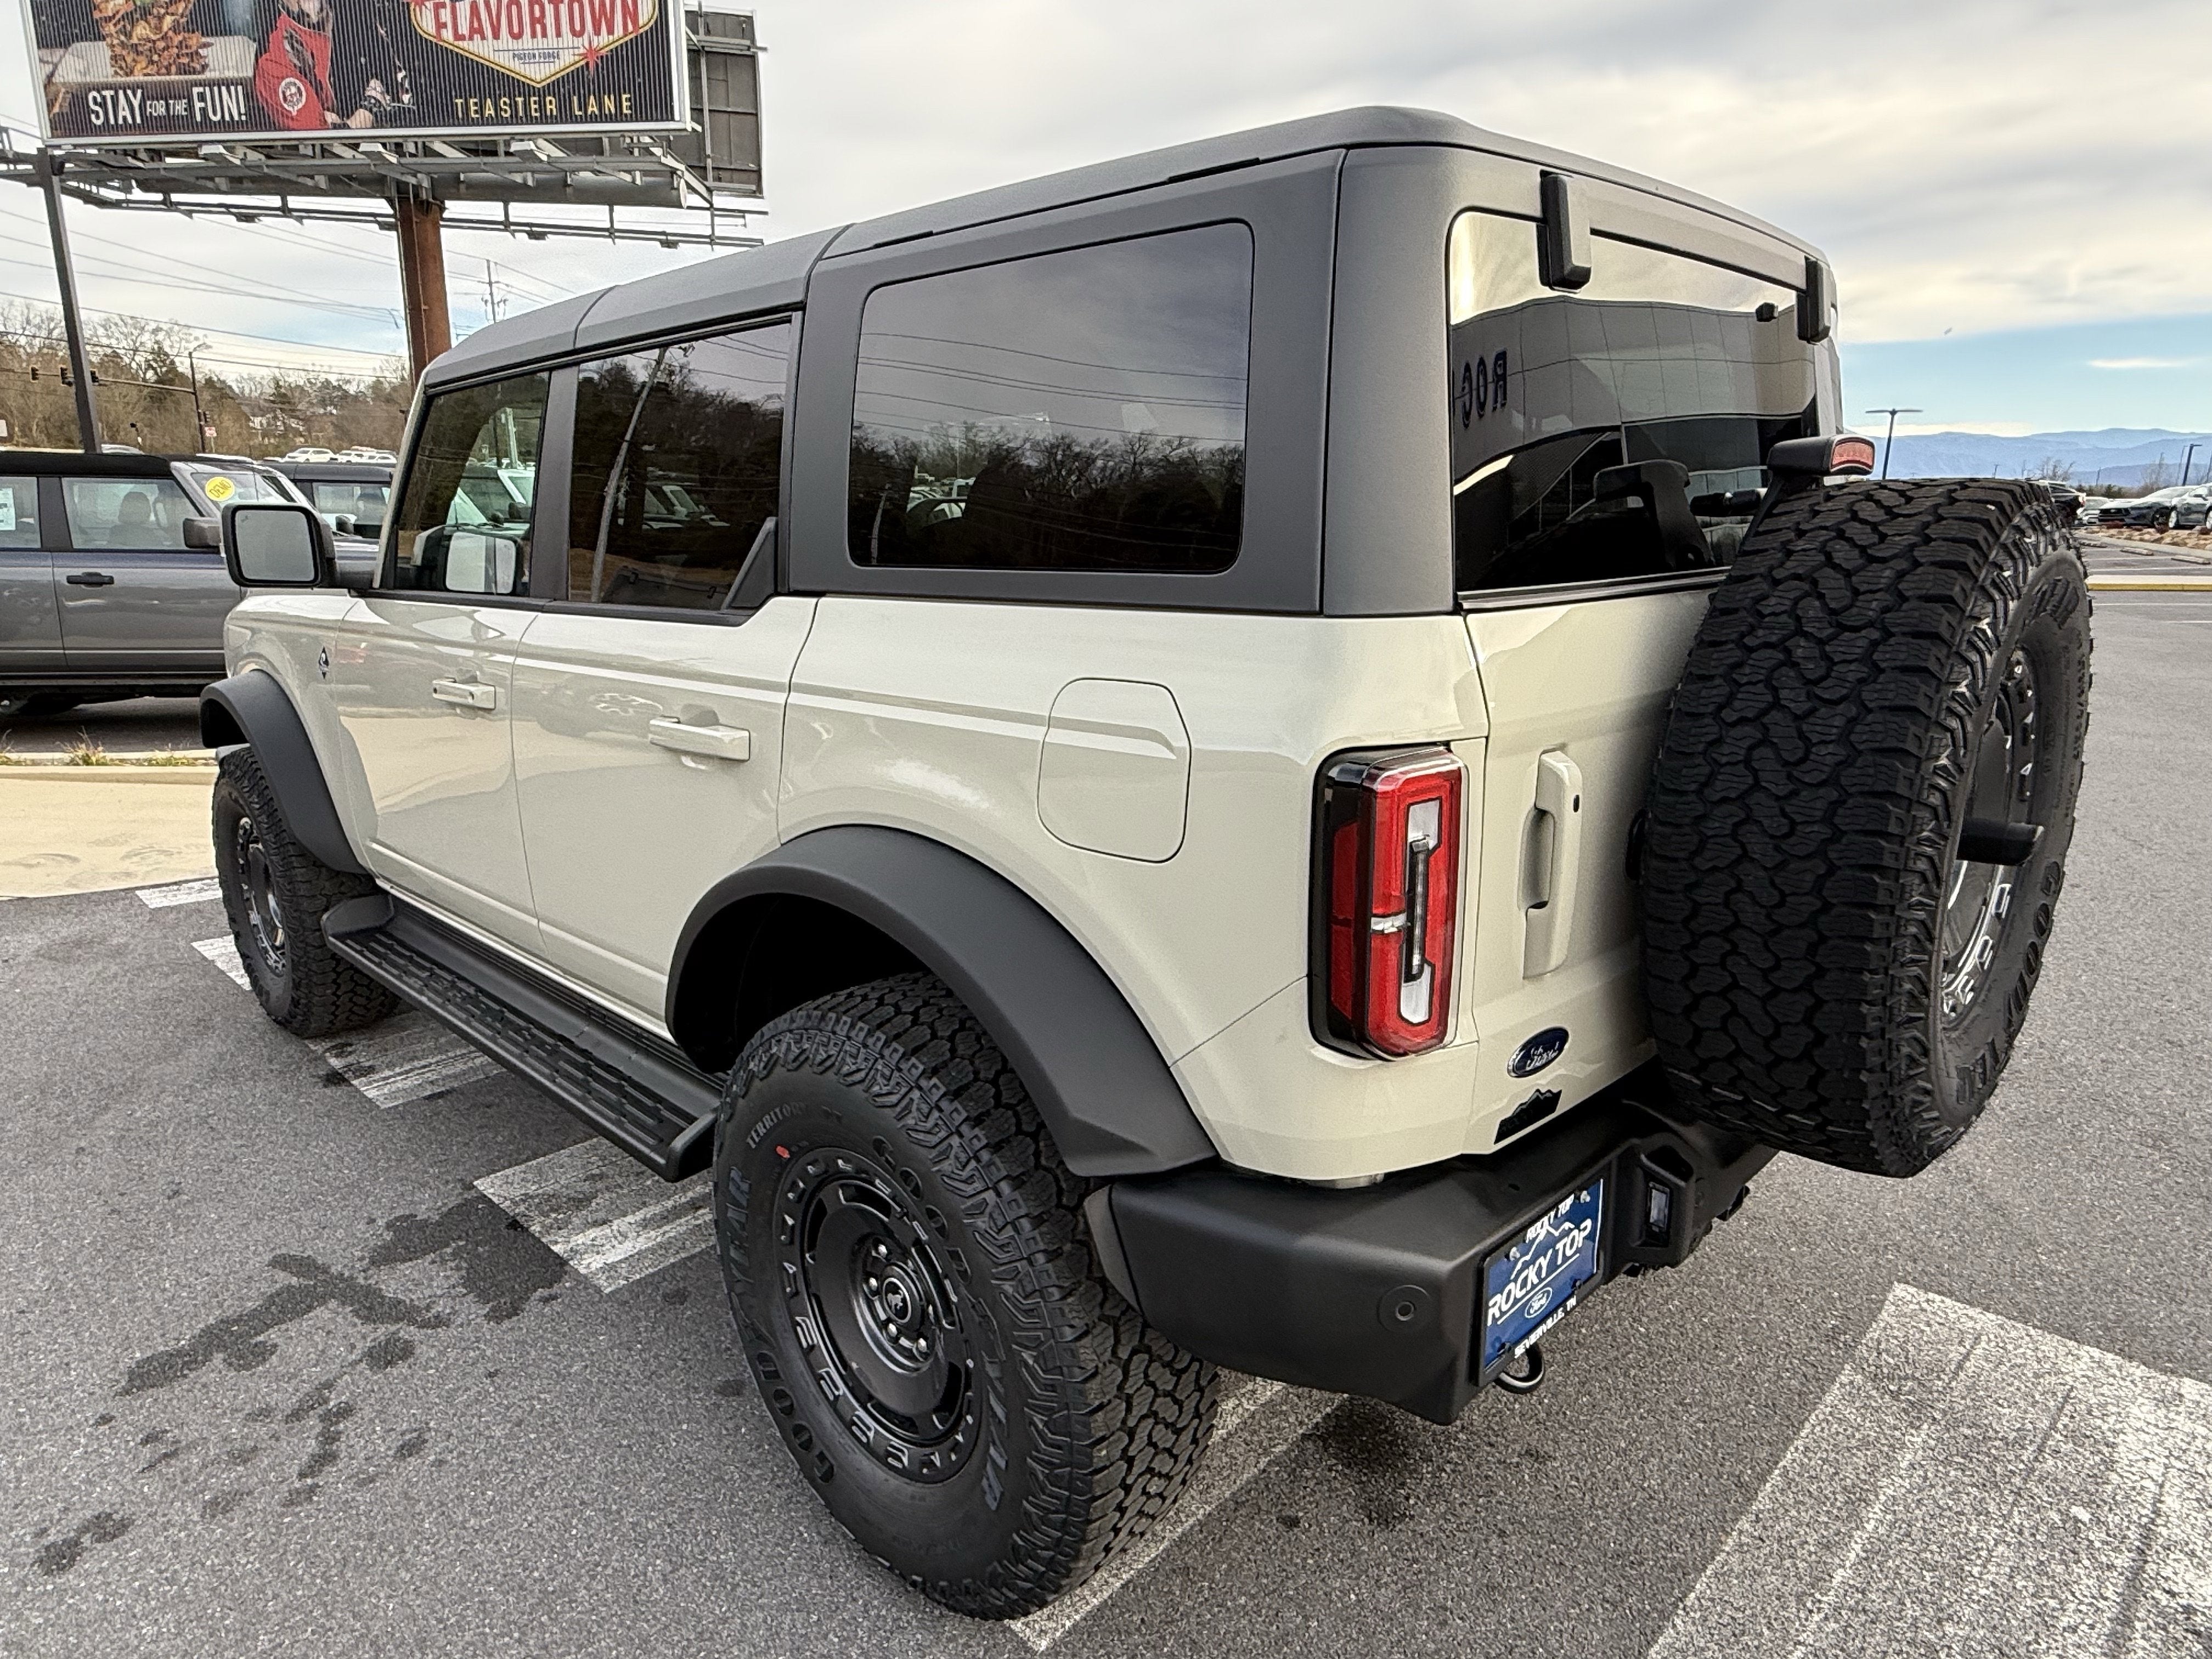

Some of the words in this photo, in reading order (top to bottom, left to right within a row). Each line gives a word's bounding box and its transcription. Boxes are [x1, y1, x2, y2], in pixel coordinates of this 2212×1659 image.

[432, 0, 641, 42] FLAVORTOWN
[88, 88, 143, 126] STAY
[146, 100, 166, 117] FOR
[168, 98, 188, 116] THE
[192, 85, 246, 122] FUN!
[454, 96, 556, 119] TEASTER
[573, 94, 633, 116] LANE
[209, 479, 232, 498] DEMO
[1526, 1207, 1557, 1243] ROCKY
[1558, 1193, 1575, 1218] TOP
[1487, 1248, 1553, 1327] ROCKY
[1555, 1218, 1592, 1265] TOP
[1566, 1295, 1577, 1311] TN
